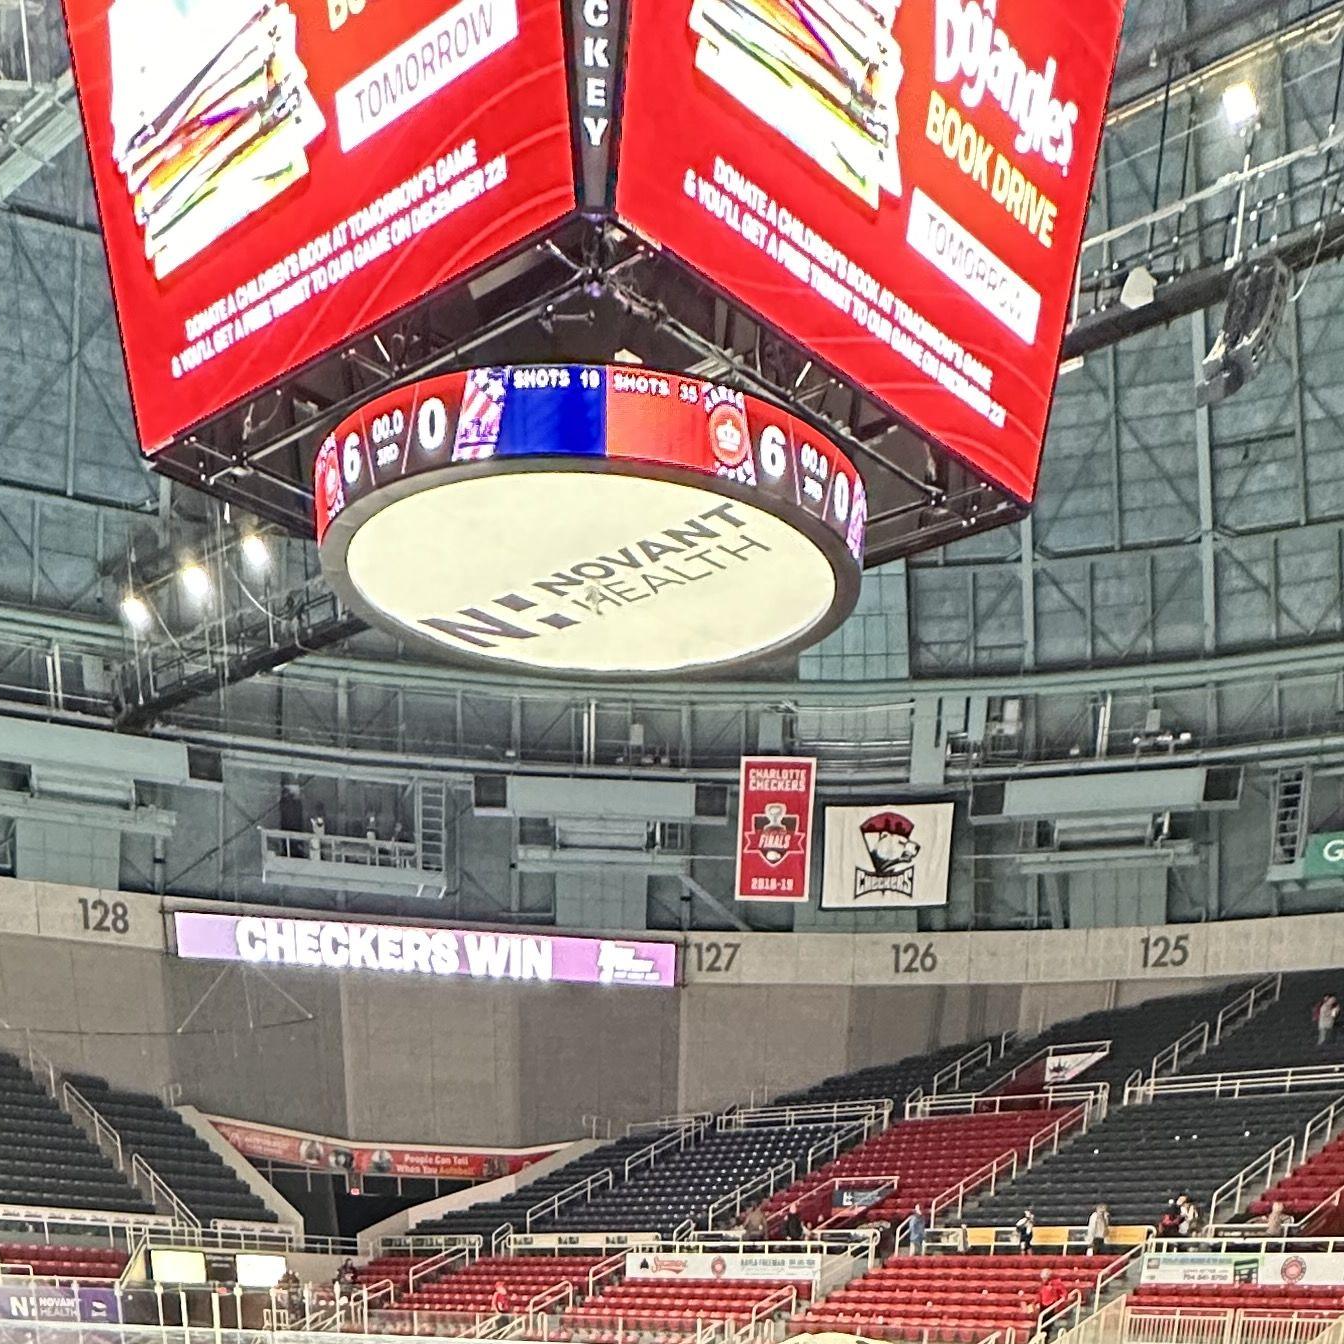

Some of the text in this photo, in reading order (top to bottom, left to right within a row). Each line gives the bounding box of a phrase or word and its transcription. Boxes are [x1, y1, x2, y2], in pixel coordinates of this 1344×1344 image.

[354, 3, 494, 124] TOMORROW
[436, 138, 477, 187] GAME
[926, 89, 1058, 249] BOOK DRIVE
[353, 229, 393, 271] GAME
[390, 214, 412, 249] ON
[513, 369, 571, 389] SHOTS
[613, 371, 670, 397] SHOTS
[417, 397, 447, 450] 0
[342, 432, 362, 483] 6
[759, 424, 787, 477] 6
[833, 471, 850, 522] 0
[532, 502, 750, 598] NOVANT
[571, 533, 773, 617] HEALTH
[748, 779, 806, 792] CHECKERS
[749, 768, 807, 780] CHARLOTTE
[856, 867, 913, 897] CHECKERS
[78, 898, 130, 935] 128
[236, 916, 457, 976] CHECKERS
[465, 934, 554, 980] WIN
[695, 942, 741, 972] 127
[891, 942, 937, 973] 126
[1140, 934, 1189, 969] 125
[39, 1297, 80, 1308] NOVANT
[40, 1307, 80, 1318] HEALTH
